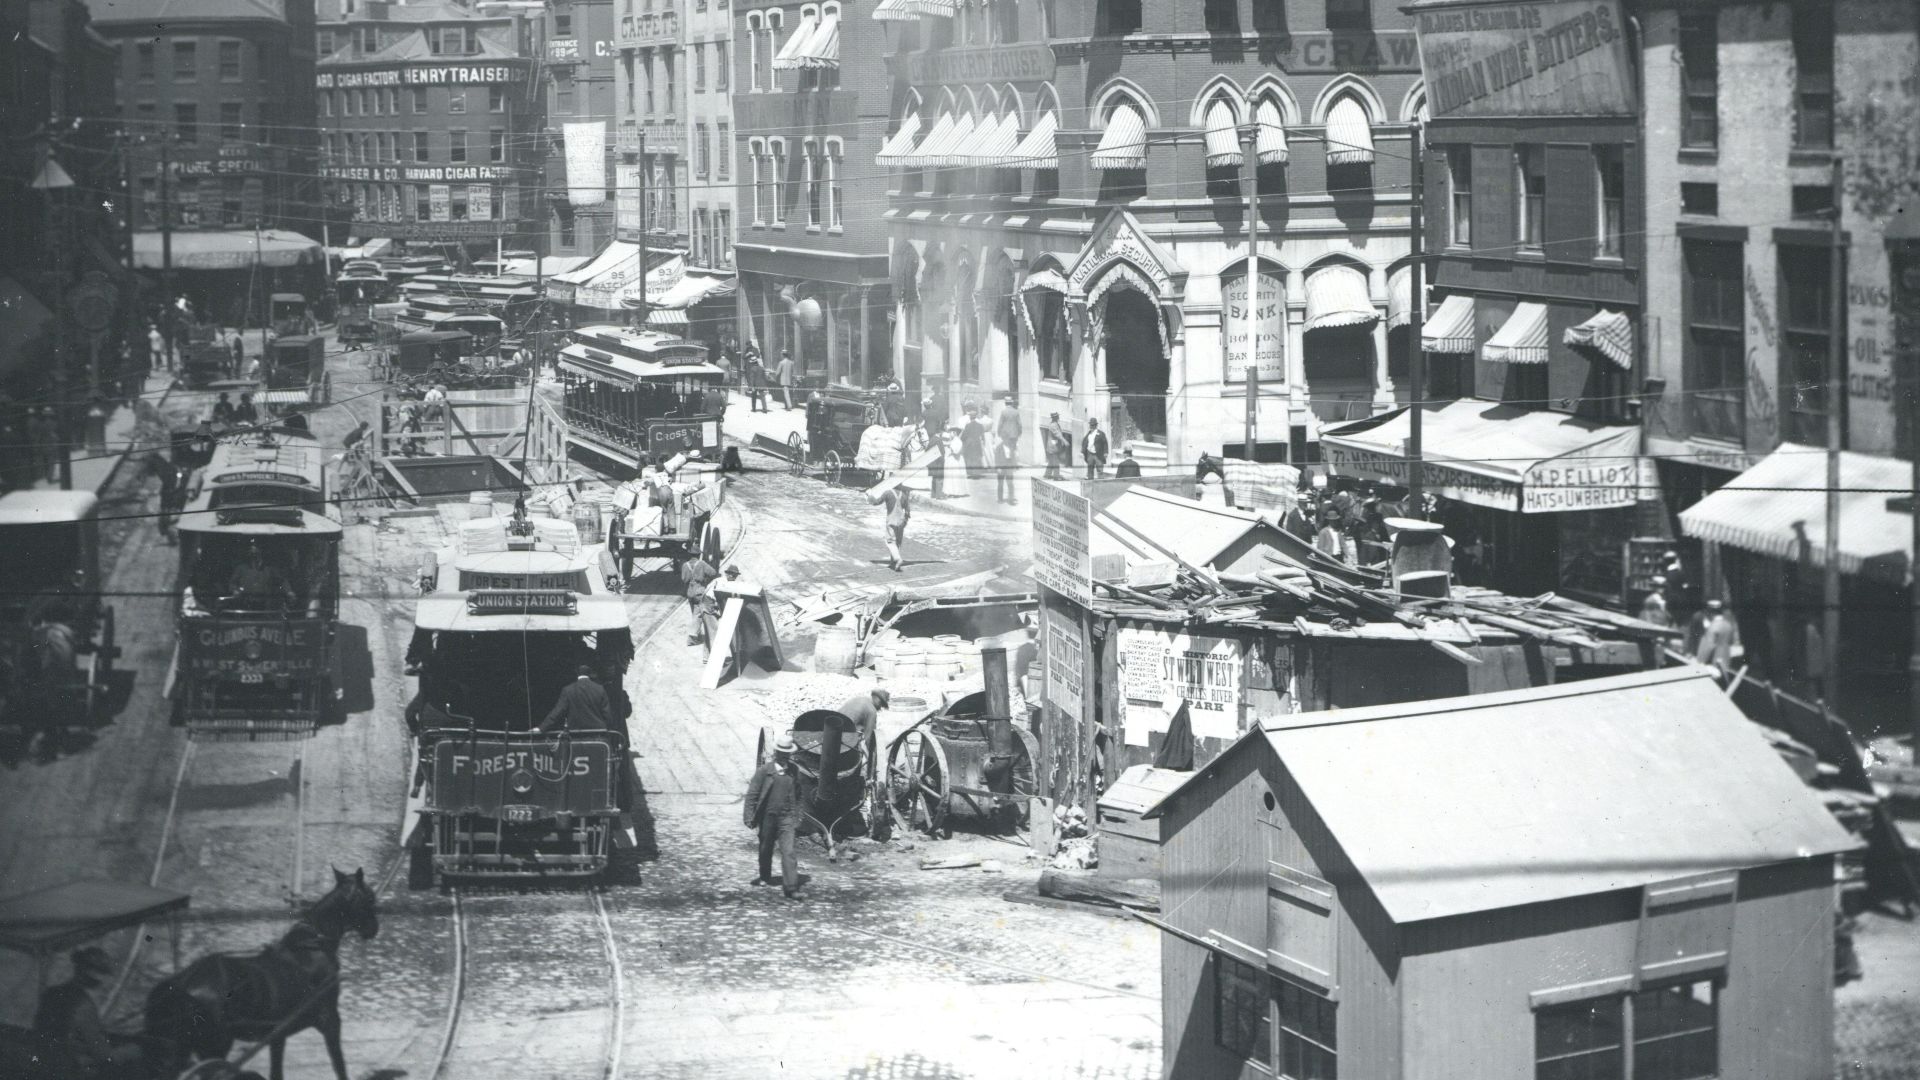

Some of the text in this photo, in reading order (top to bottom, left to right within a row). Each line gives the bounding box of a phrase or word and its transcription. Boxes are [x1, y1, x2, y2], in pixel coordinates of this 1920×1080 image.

[404, 68, 448, 83] HENRY
[449, 67, 509, 82] TRAISER
[157, 161, 212, 174] RPTURE
[405, 168, 443, 180] HARVARD
[445, 167, 478, 180] CIGAR
[611, 271, 626, 280] 95
[658, 268, 672, 277] 93
[1230, 291, 1276, 301] SECRITY
[1229, 352, 1250, 361] BAN
[1855, 337, 1881, 363] OIL
[656, 429, 687, 441] CROSS
[1527, 492, 1557, 509] HATS
[478, 594, 565, 607] UNION STATION
[1182, 651, 1229, 661] HISTORIC
[1206, 661, 1233, 688] WEST
[1211, 688, 1233, 703] RIVER
[1186, 700, 1225, 712] PARK
[452, 752, 591, 776] FOREST HILLS
